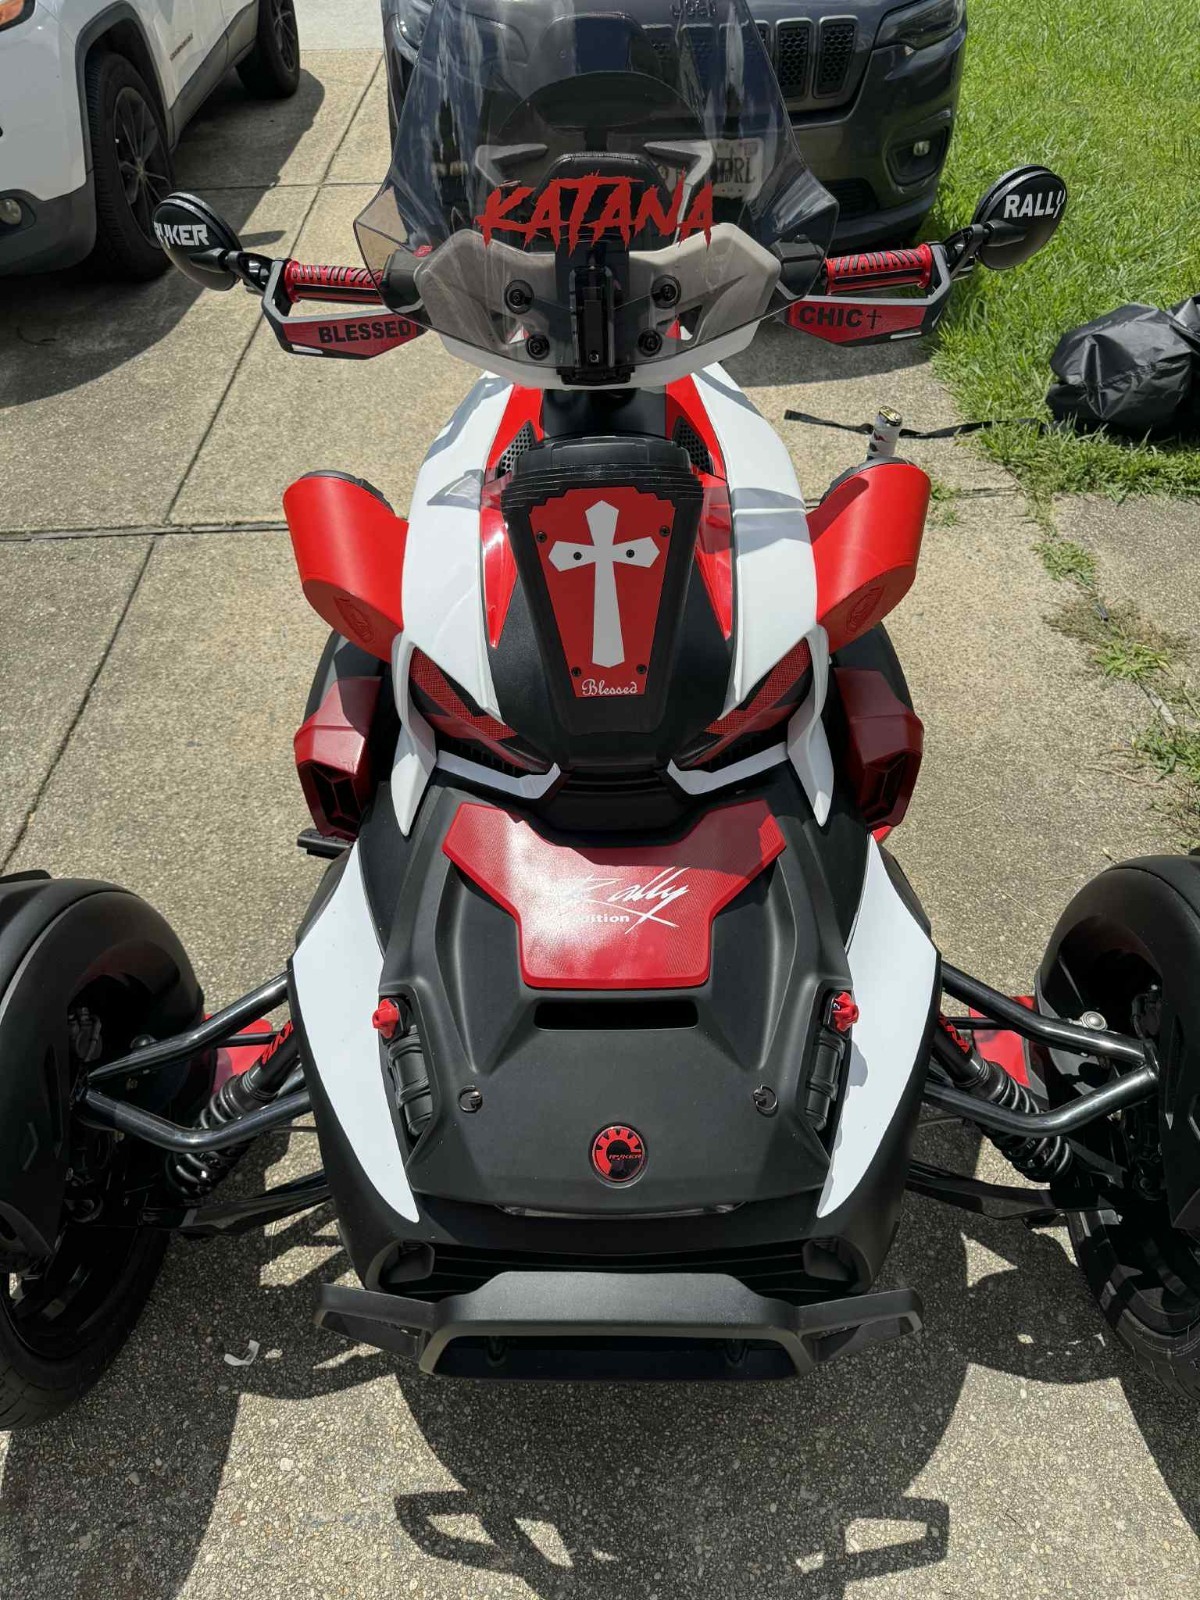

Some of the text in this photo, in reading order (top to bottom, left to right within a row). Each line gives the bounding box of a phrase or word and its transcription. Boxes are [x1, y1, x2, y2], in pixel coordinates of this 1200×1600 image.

[474, 165, 719, 257] KATANA
[1003, 189, 1067, 219] RALLY
[799, 305, 863, 328] CHIC
[318, 319, 412, 344] BLESSED
[581, 678, 638, 696] Blessed
